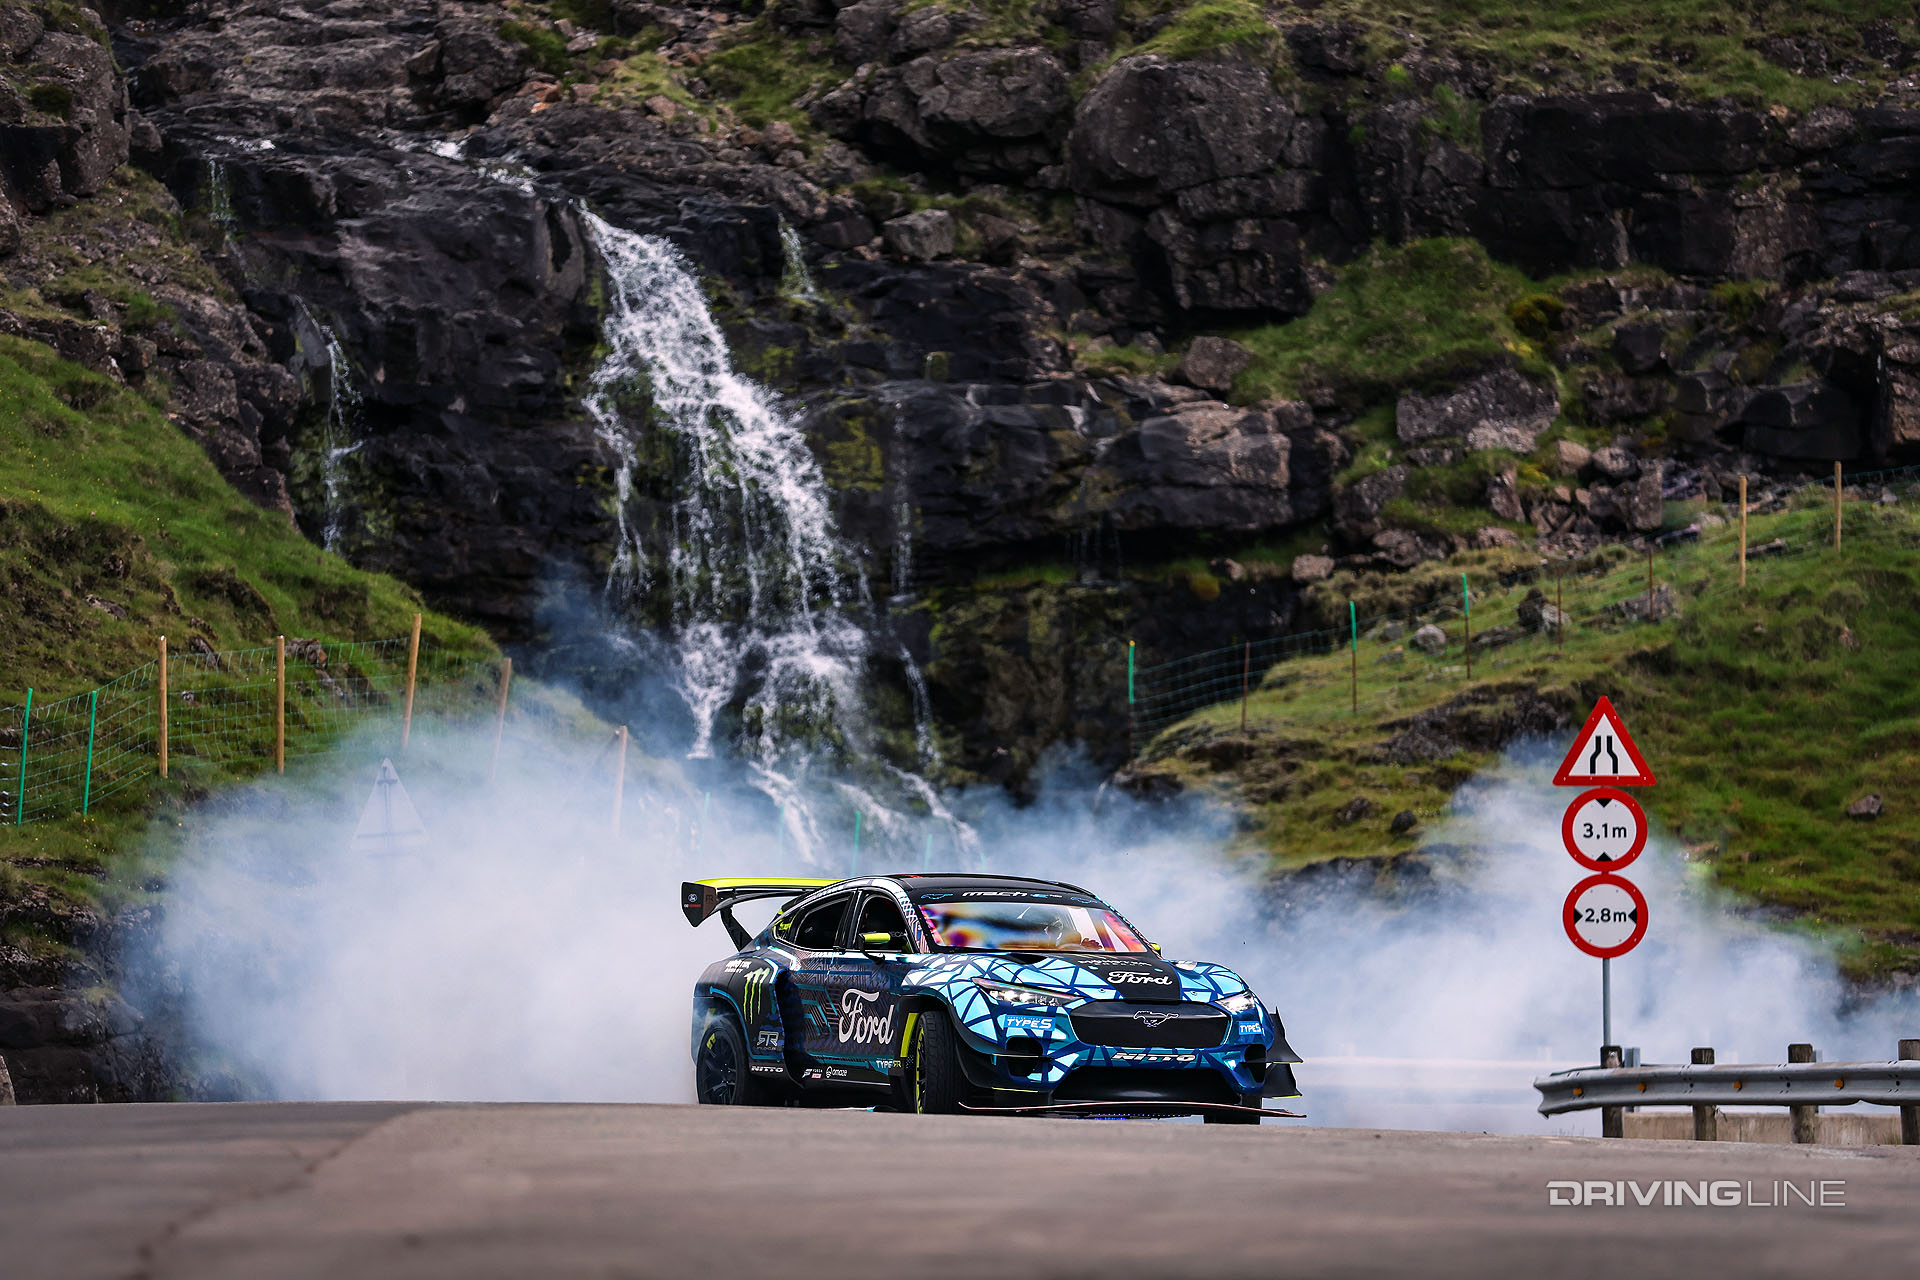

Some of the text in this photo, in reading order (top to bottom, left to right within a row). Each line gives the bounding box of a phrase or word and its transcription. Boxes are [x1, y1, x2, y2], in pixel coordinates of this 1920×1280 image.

[1583, 823, 1627, 840] 3,1m
[1584, 907, 1627, 924] 2,8m
[1107, 971, 1173, 985] Ford
[839, 988, 895, 1045] Ford
[1112, 1052, 1196, 1062] NITTO
[751, 1065, 784, 1073] NITTO
